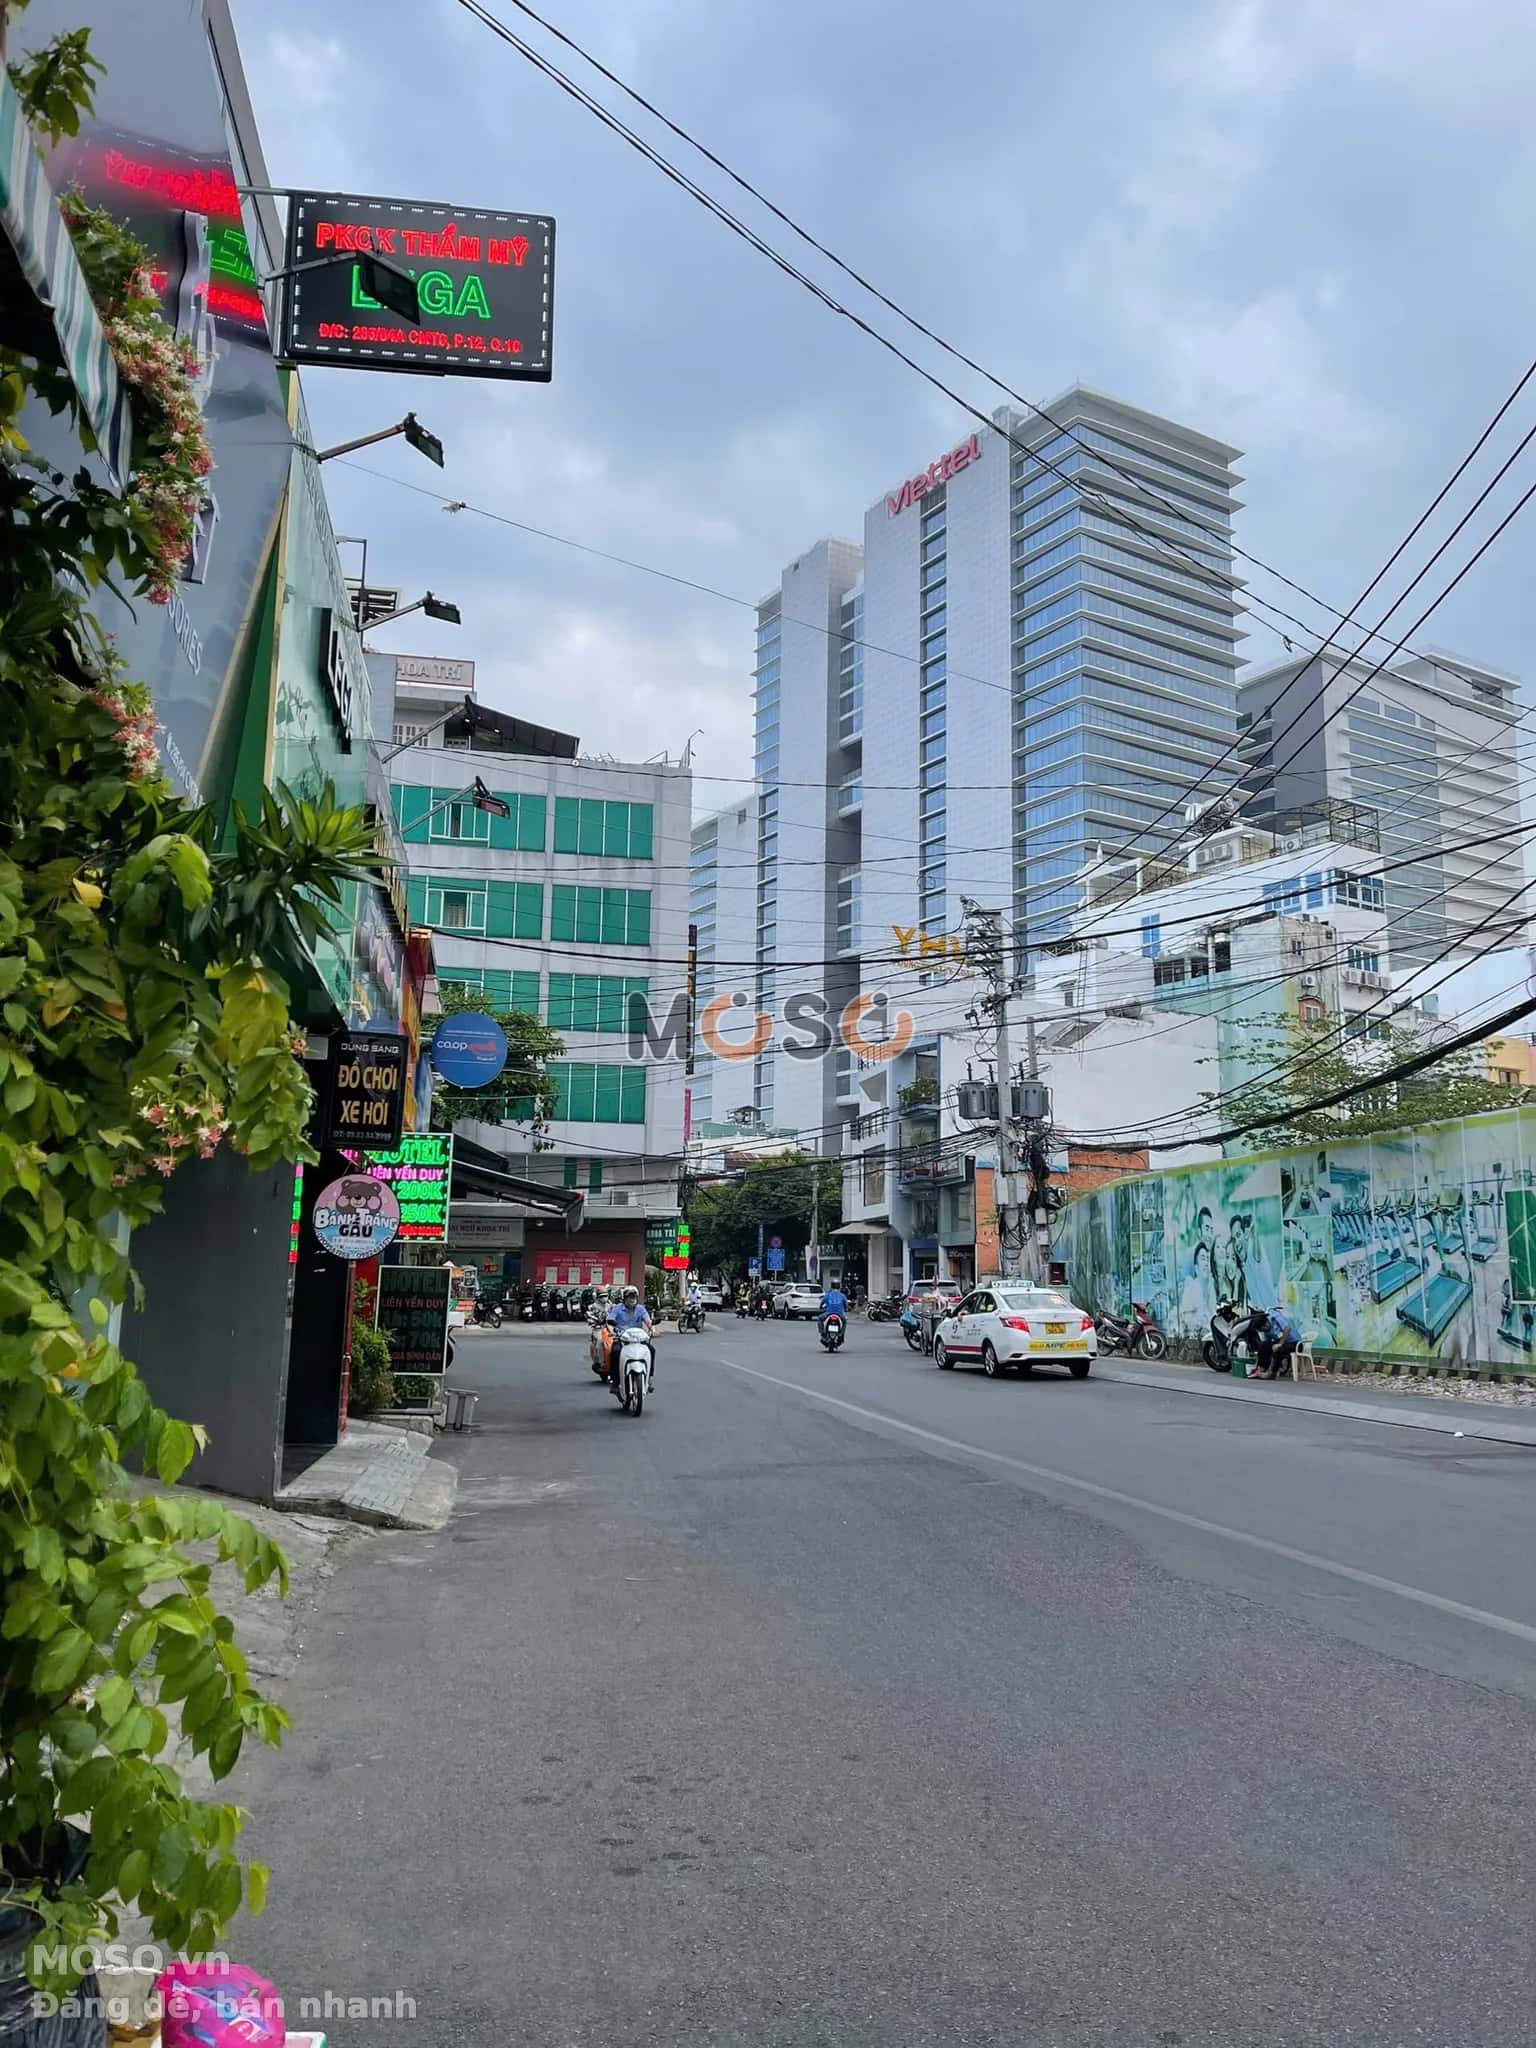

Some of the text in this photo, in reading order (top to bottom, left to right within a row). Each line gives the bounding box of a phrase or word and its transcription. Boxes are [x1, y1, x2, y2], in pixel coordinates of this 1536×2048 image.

[487, 235, 529, 266] MỸ
[362, 1063, 398, 1090] CHƠI
[340, 1098, 388, 1125] XE HƠI
[419, 1167, 444, 1180] DUY
